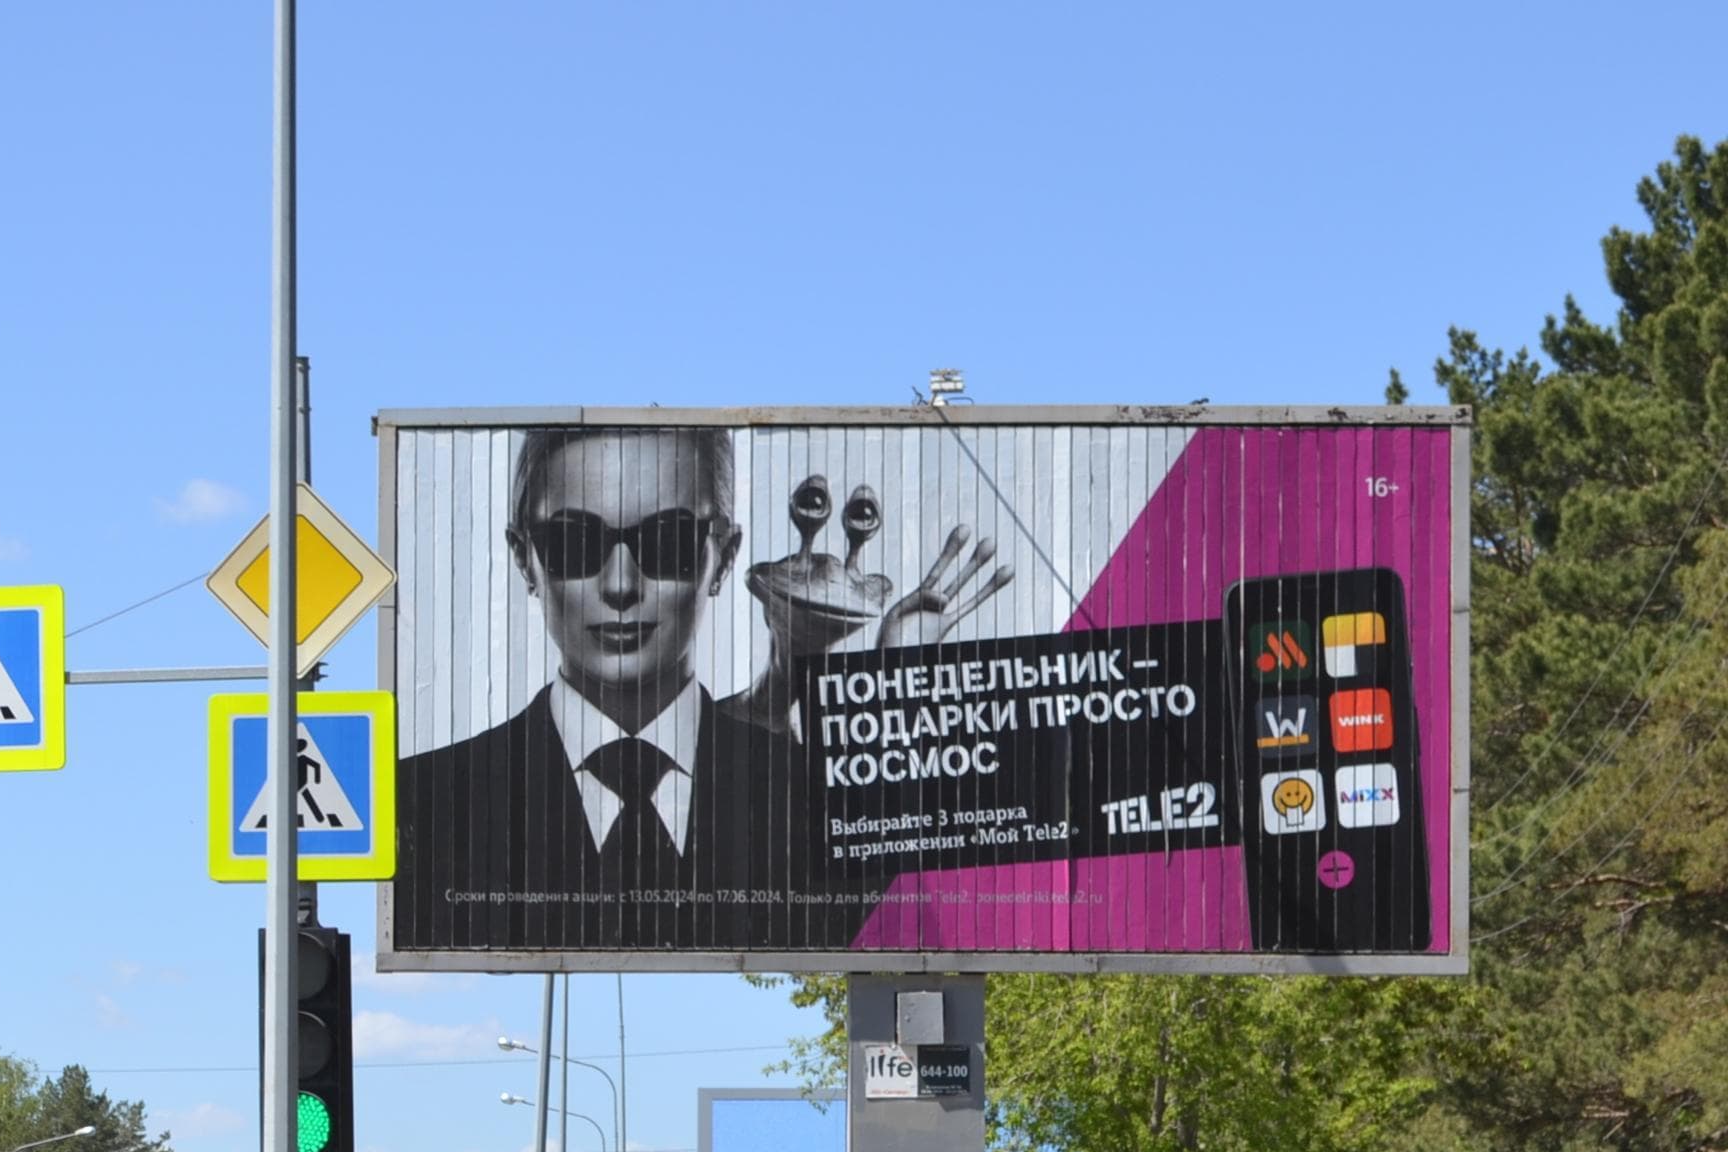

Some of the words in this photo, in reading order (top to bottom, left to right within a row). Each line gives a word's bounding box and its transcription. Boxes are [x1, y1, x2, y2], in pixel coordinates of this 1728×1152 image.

[1365, 477, 1399, 497] 16+
[818, 649, 1124, 706] ПОНЕДЕЛЬНИК
[822, 699, 1018, 747] ПОДАРКИ
[1029, 684, 1196, 729] ПРОСТО
[825, 741, 1000, 788] КОСМОС
[831, 811, 933, 836] Выбирайте
[938, 809, 948, 826] 3
[953, 806, 1028, 831] подарка
[1101, 781, 1219, 835] TELE2
[833, 846, 843, 859] в
[849, 835, 965, 860] приложении
[445, 888, 486, 904] Сроки
[489, 891, 569, 905] проведения
[698, 892, 714, 903] по
[788, 890, 832, 904] Только
[834, 892, 860, 905] для
[863, 890, 932, 904] абонентов
[870, 1050, 913, 1078] life
[920, 1064, 969, 1077] 644-100
